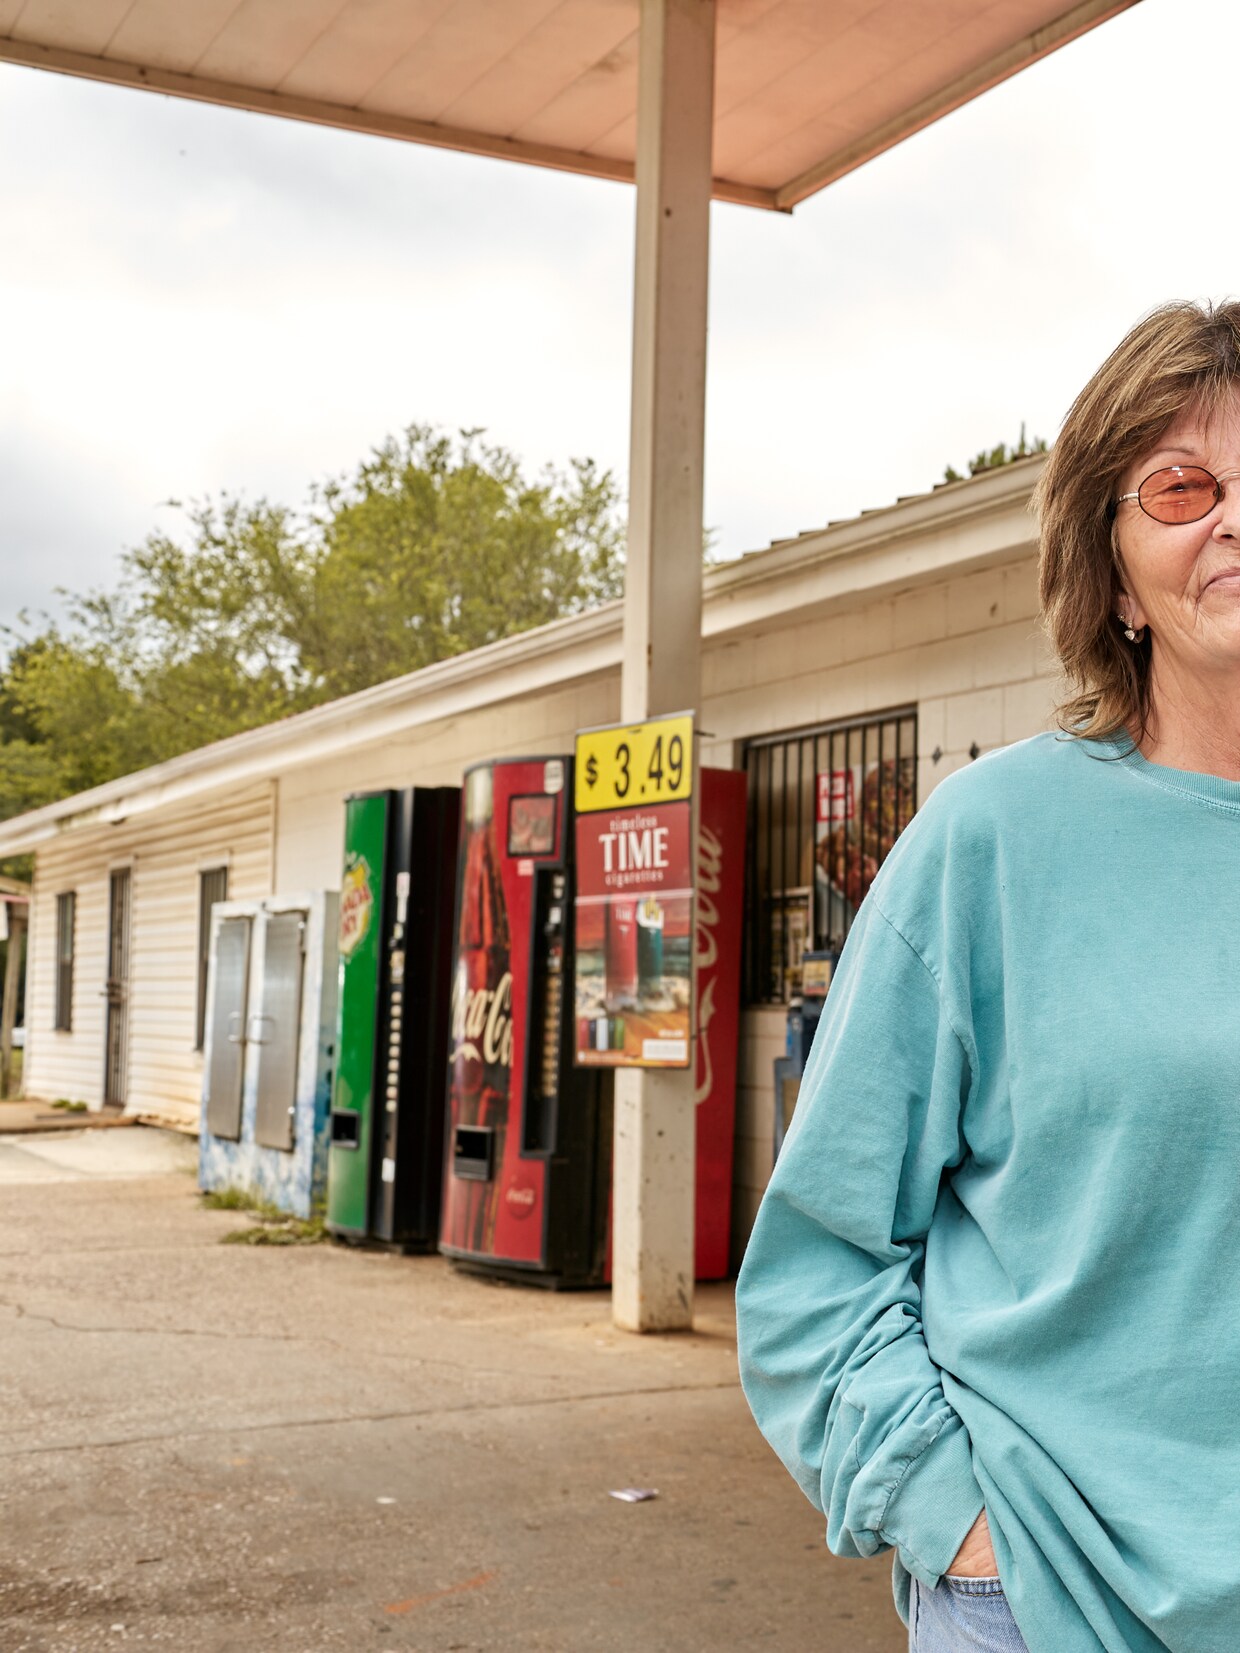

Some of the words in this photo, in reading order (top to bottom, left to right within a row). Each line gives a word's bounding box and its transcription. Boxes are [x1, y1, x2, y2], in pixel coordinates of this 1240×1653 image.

[585, 754, 599, 790] $
[614, 735, 683, 798] 3.49
[598, 826, 669, 873] TIME
